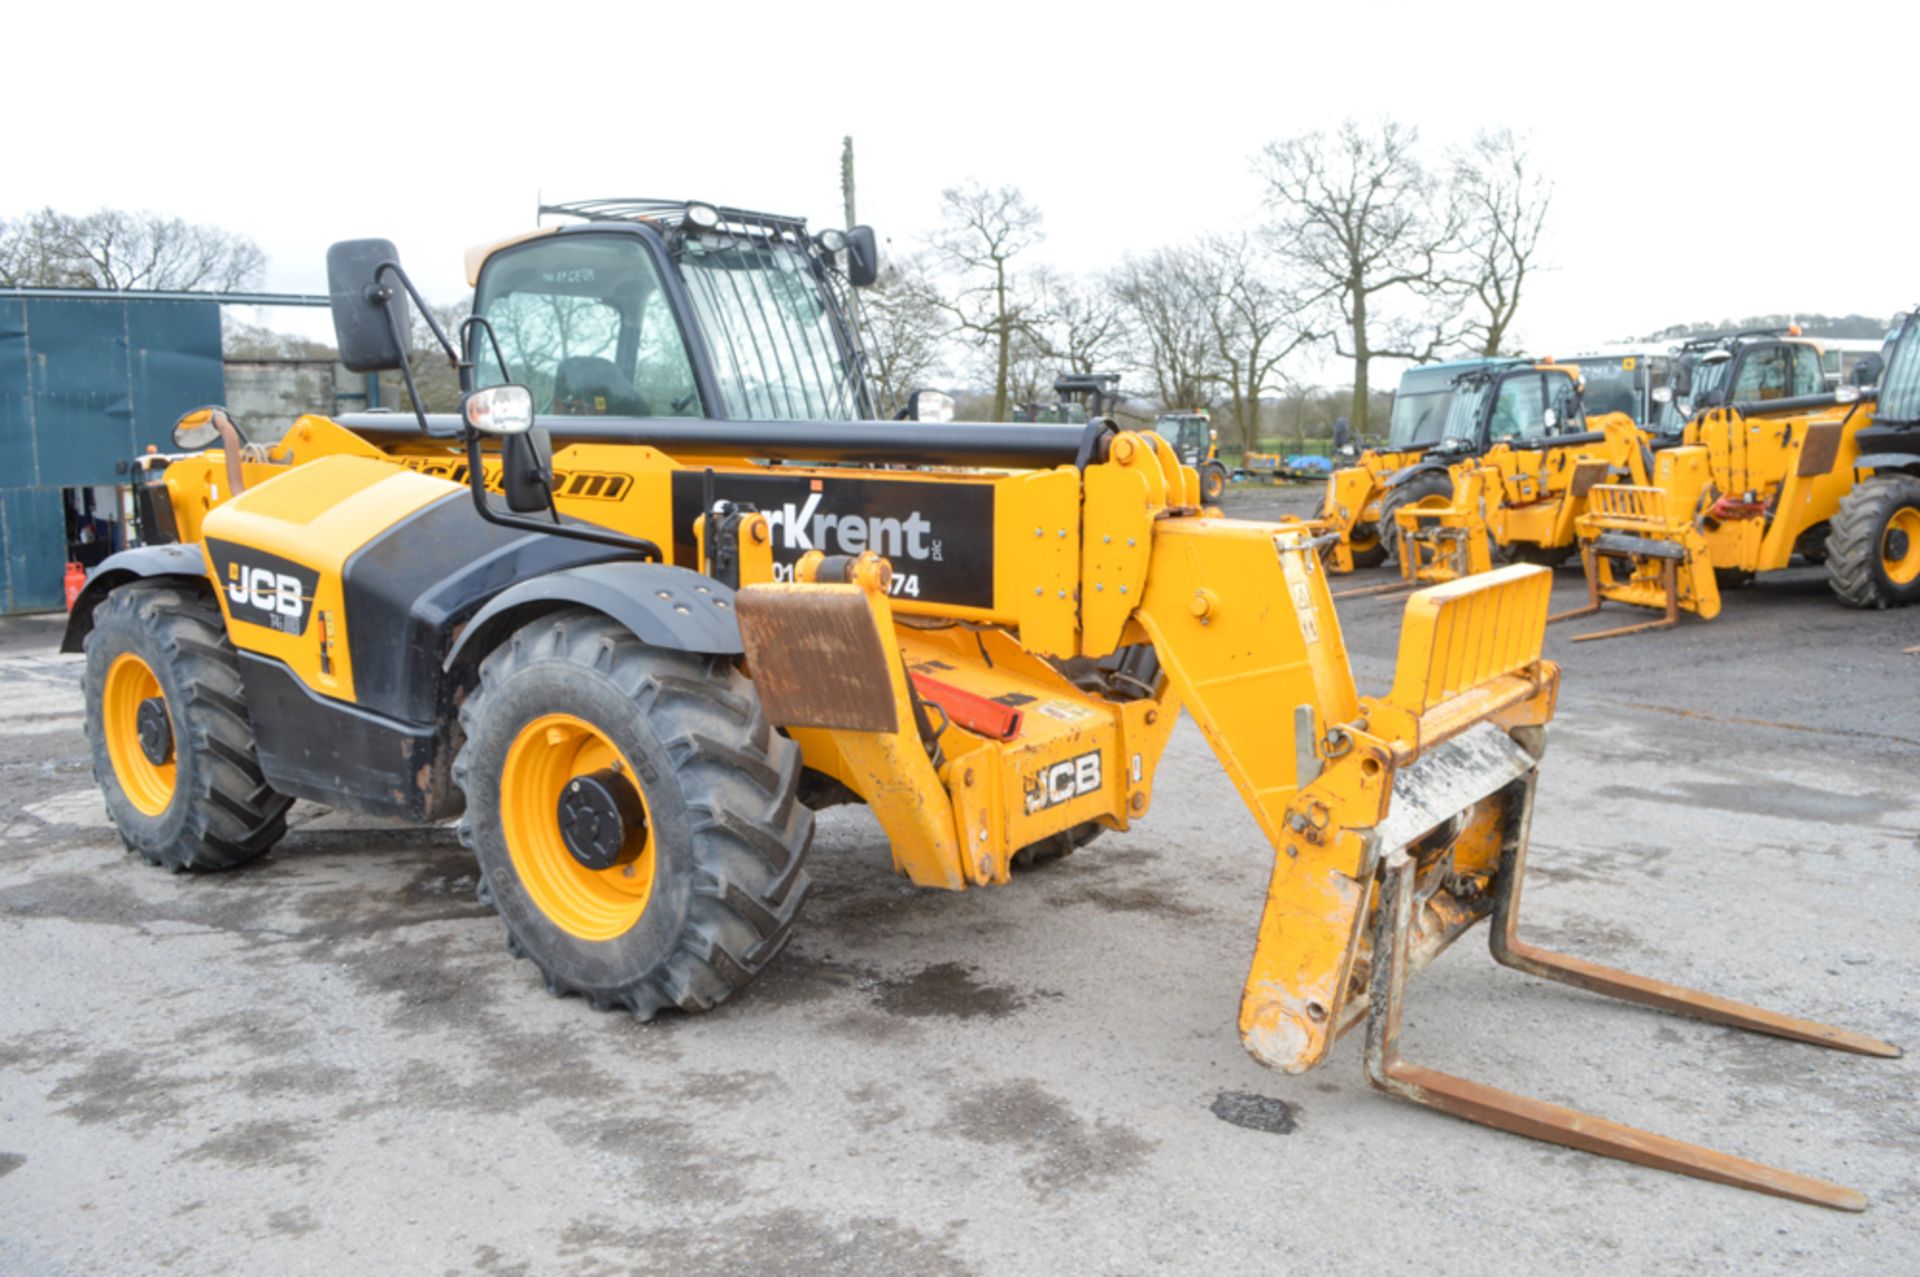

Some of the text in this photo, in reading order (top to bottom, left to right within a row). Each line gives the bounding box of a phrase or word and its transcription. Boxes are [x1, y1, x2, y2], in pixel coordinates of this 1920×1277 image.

[712, 492, 931, 560] rkrent
[932, 539, 944, 562] plc
[228, 563, 304, 617] JCB
[772, 562, 920, 597] 01 74
[1025, 753, 1101, 813] JCB
